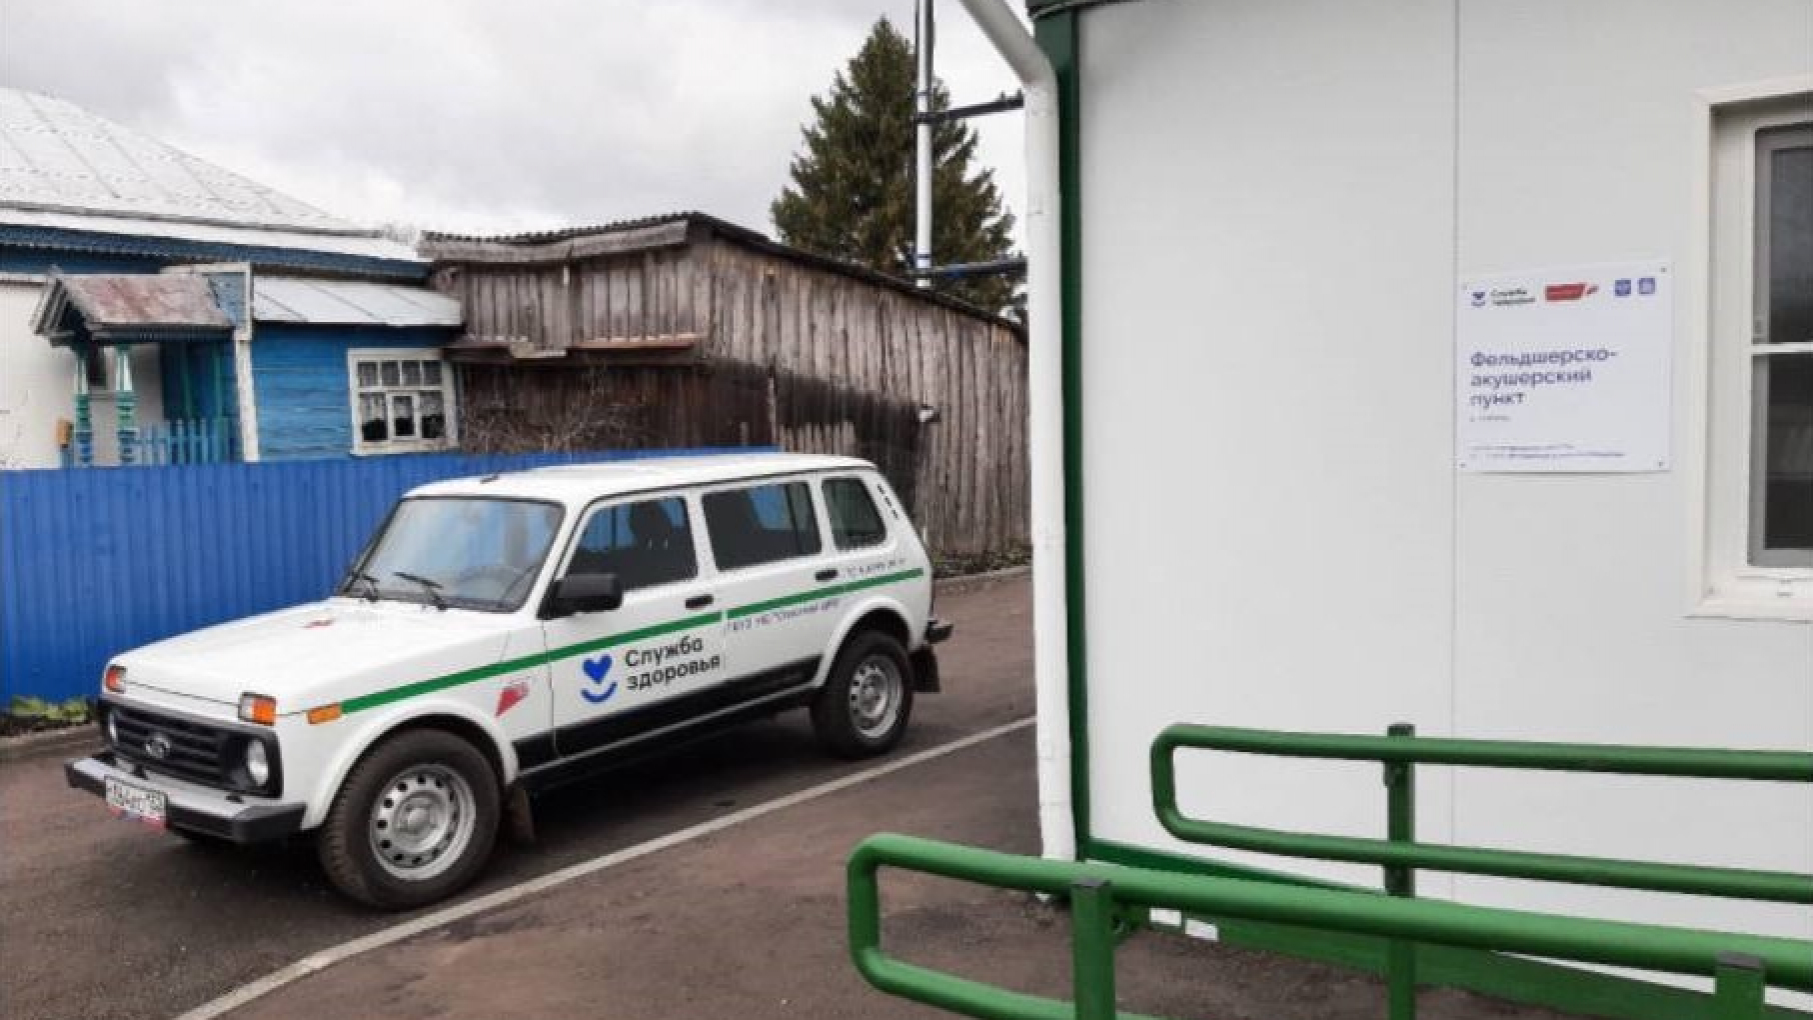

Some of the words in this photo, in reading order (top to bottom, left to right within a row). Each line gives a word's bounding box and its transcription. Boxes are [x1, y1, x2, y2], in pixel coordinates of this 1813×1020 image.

[1470, 348, 1618, 367] Фельдшерско-
[1470, 368, 1592, 389] акушерский
[1469, 391, 1526, 410] пункт
[625, 634, 703, 667] Служба
[626, 653, 720, 690] здоровья
